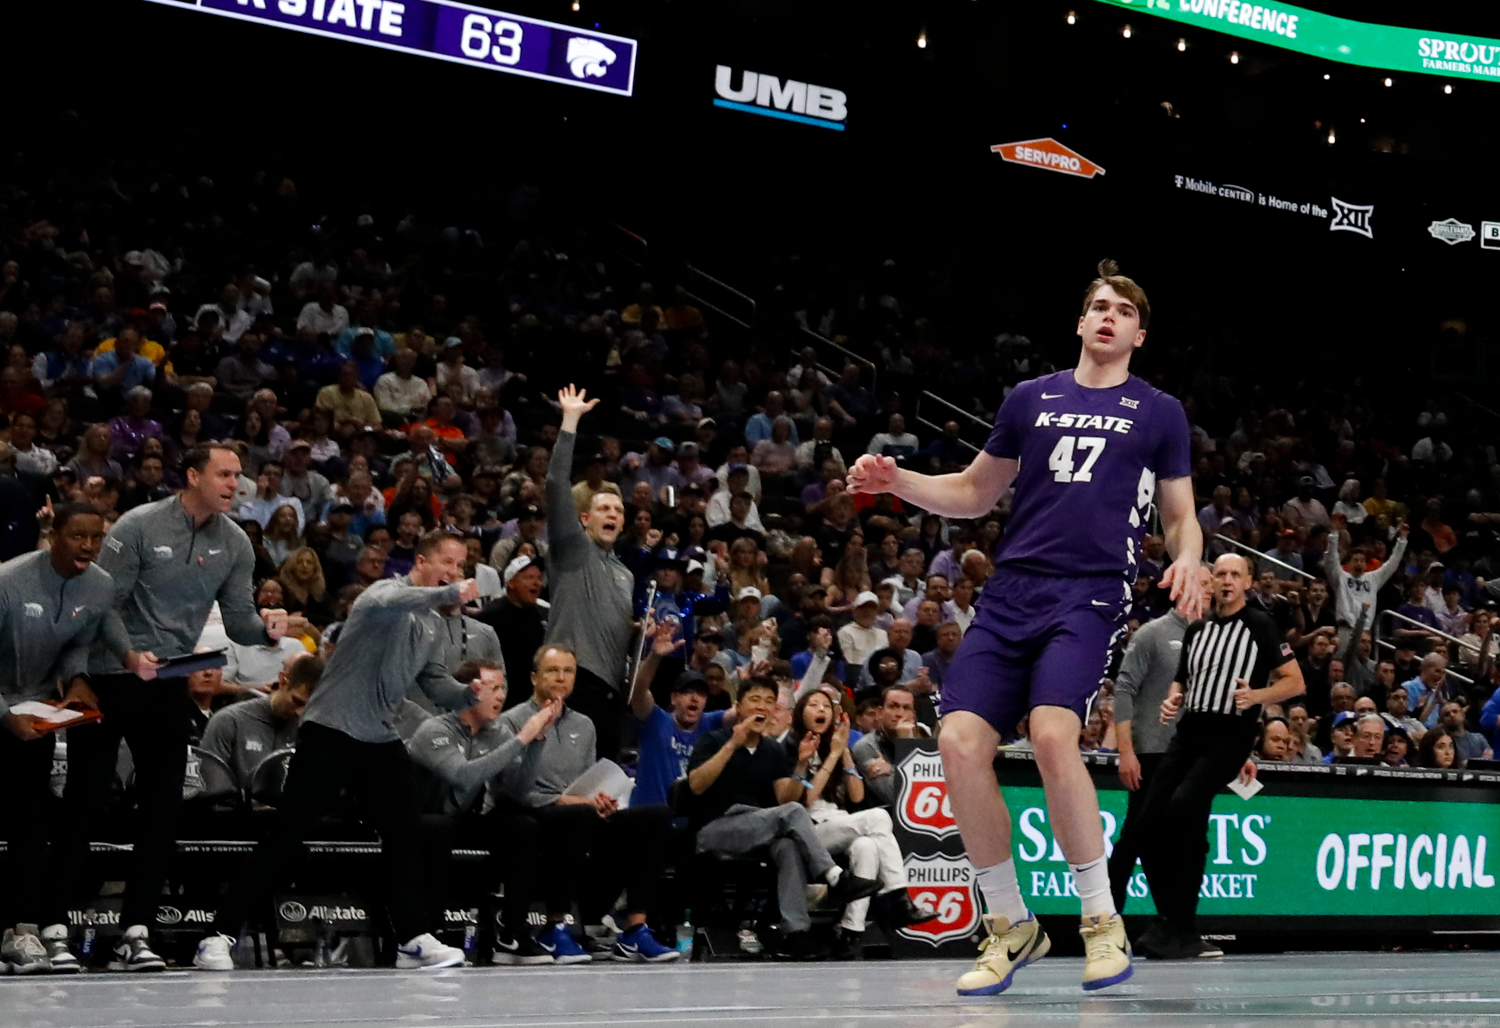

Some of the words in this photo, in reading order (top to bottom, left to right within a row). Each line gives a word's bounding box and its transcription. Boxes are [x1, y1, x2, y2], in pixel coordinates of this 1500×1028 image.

[460, 13, 524, 66] 63
[1423, 58, 1472, 73] FARMERS
[715, 64, 848, 121] UMB
[1014, 146, 1081, 171] SERVPRO
[1185, 177, 1217, 195] Mobile
[1218, 187, 1251, 202] CENTER
[1258, 193, 1266, 205] is
[1268, 195, 1298, 212] Home
[1300, 203, 1310, 215] of
[1311, 204, 1328, 218] the
[1034, 412, 1134, 434] K-STATE
[1048, 435, 1107, 483] 47
[908, 867, 970, 882] PHILLIPS
[1316, 832, 1495, 890] OFFICIAL
